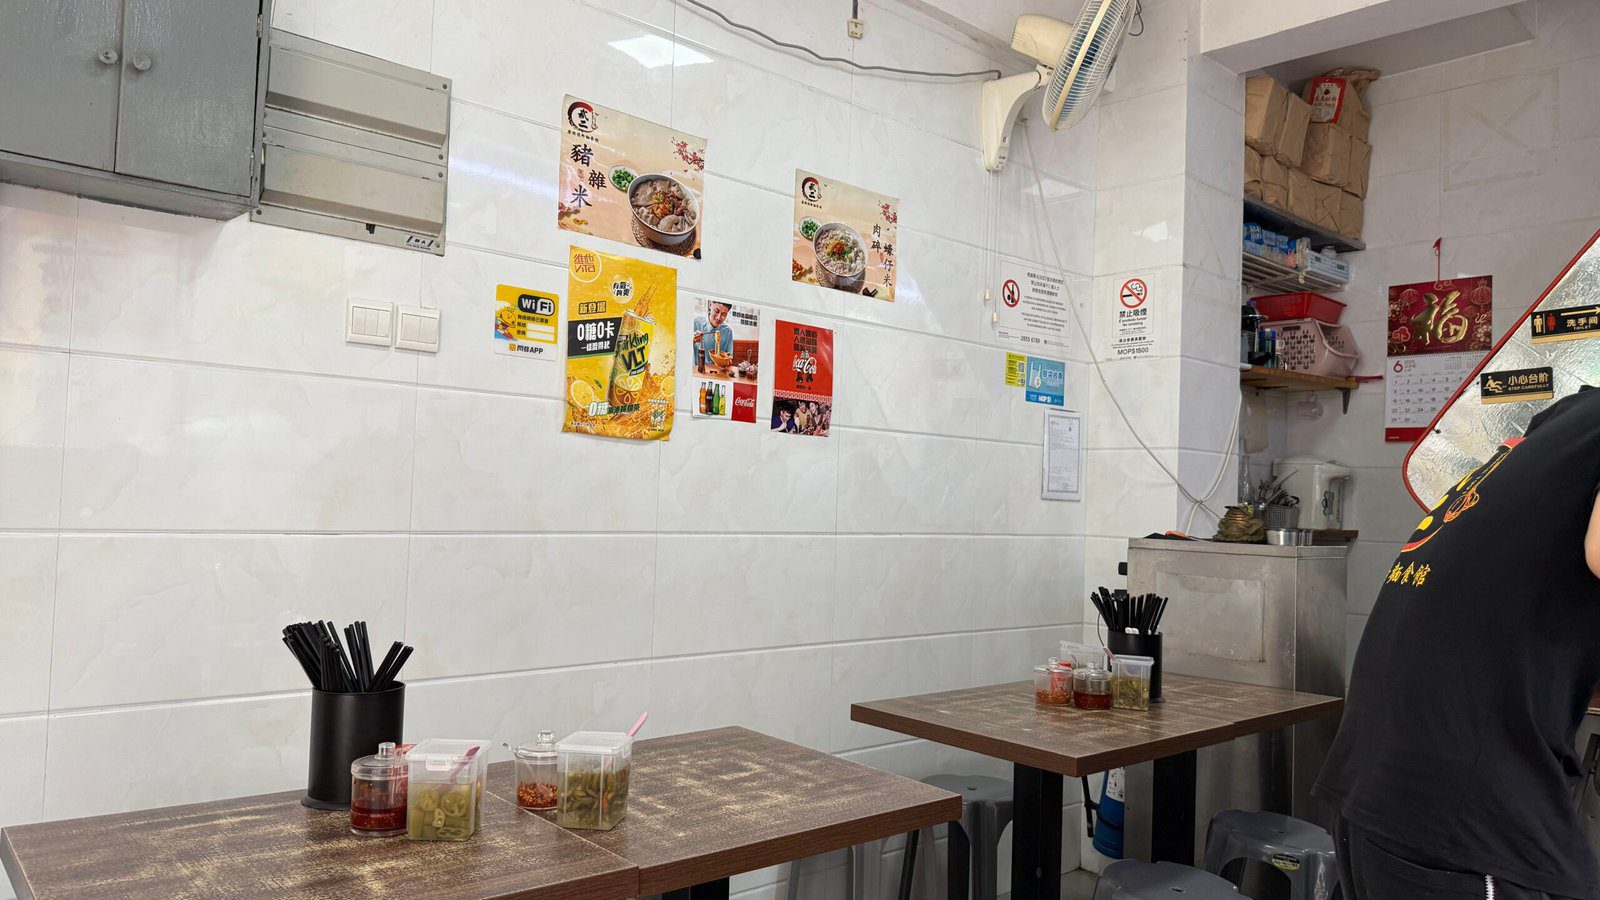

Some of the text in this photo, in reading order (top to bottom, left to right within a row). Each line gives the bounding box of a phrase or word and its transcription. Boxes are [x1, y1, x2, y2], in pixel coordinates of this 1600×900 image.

[570, 143, 607, 208] 豬雜米
[871, 223, 881, 254] 肉碎
[883, 243, 894, 288] 蠔仔米
[521, 297, 552, 313] WiFi
[1411, 290, 1468, 346] 福
[1566, 316, 1598, 328] 洗手间
[577, 320, 615, 341] 0糖0卡
[621, 347, 647, 371] VLT
[1393, 360, 1403, 373] 6
[1508, 373, 1549, 386] 小心台阶
[735, 396, 756, 408] Coca-Cola
